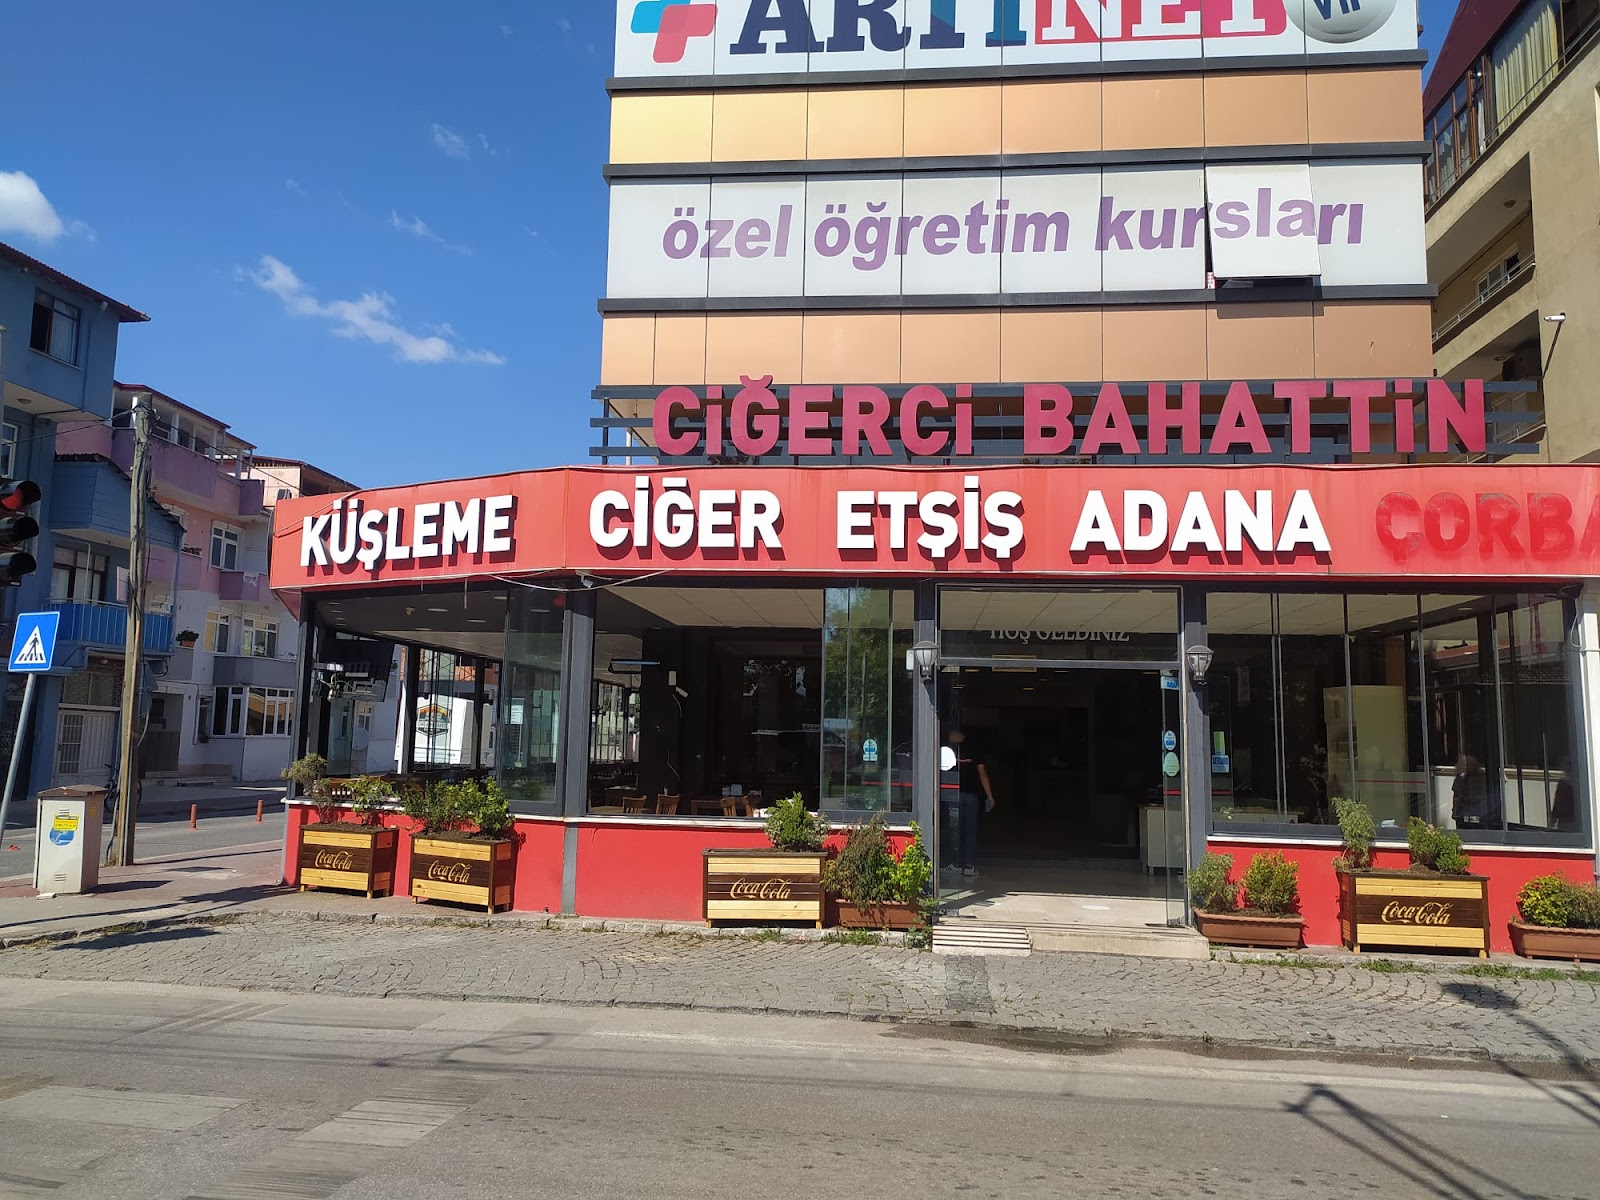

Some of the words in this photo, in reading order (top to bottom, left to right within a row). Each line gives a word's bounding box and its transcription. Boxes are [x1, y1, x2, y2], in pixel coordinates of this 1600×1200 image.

[662, 204, 793, 260] özel
[814, 201, 1071, 271] öğretim
[1095, 187, 1364, 251] kursları
[300, 494, 513, 570] KÜŞLEME
[836, 475, 1024, 558] ETŞİŞ
[1069, 489, 1332, 553] ADANA
